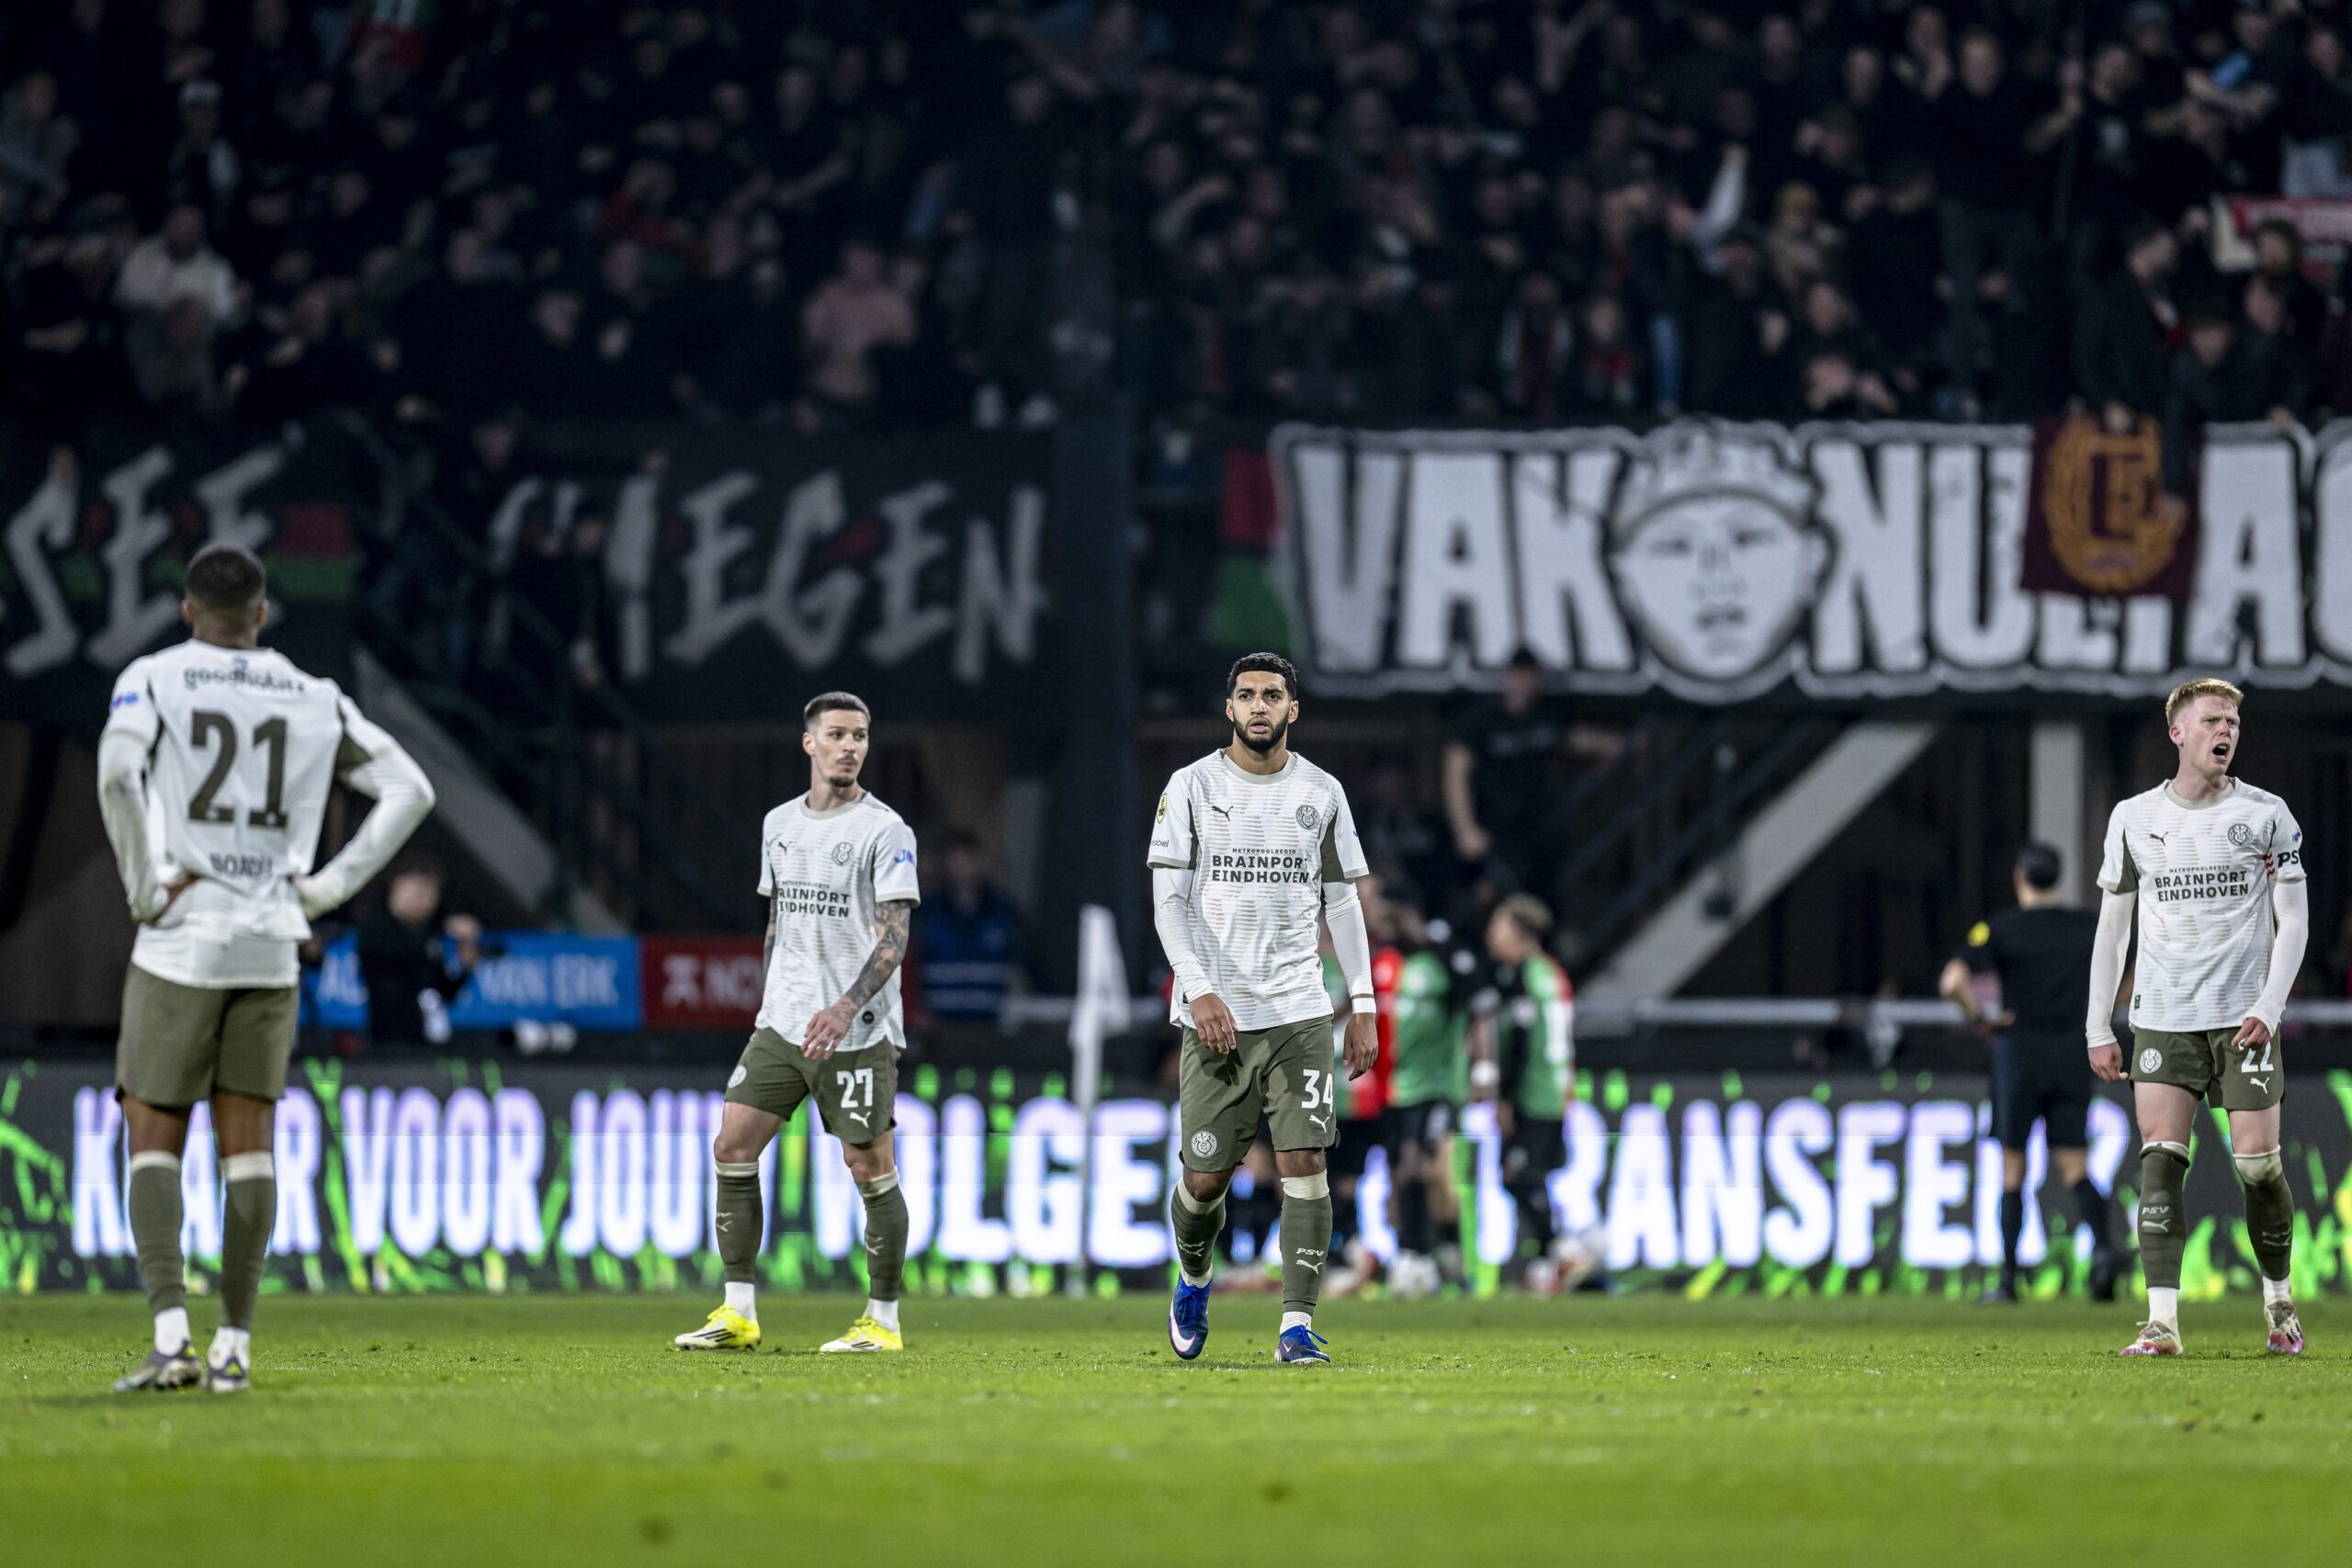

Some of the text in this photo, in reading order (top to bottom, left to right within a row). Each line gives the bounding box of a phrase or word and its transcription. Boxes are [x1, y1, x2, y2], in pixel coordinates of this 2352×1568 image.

[1294, 445, 1637, 672] VAK
[188, 710, 290, 829] 21
[2277, 850, 2299, 869] PS
[1212, 870, 1309, 884] EINDHOVEN
[2154, 870, 2247, 888] BRAINPORT
[2157, 883, 2248, 902] EINDHOVEN
[836, 1067, 873, 1109] 27
[1301, 1068, 1333, 1112] 34
[71, 1087, 322, 1258] KAR
[340, 1087, 545, 1258] VOOR
[2142, 1206, 2170, 1214] PSV
[1296, 1247, 1325, 1257] PSV
